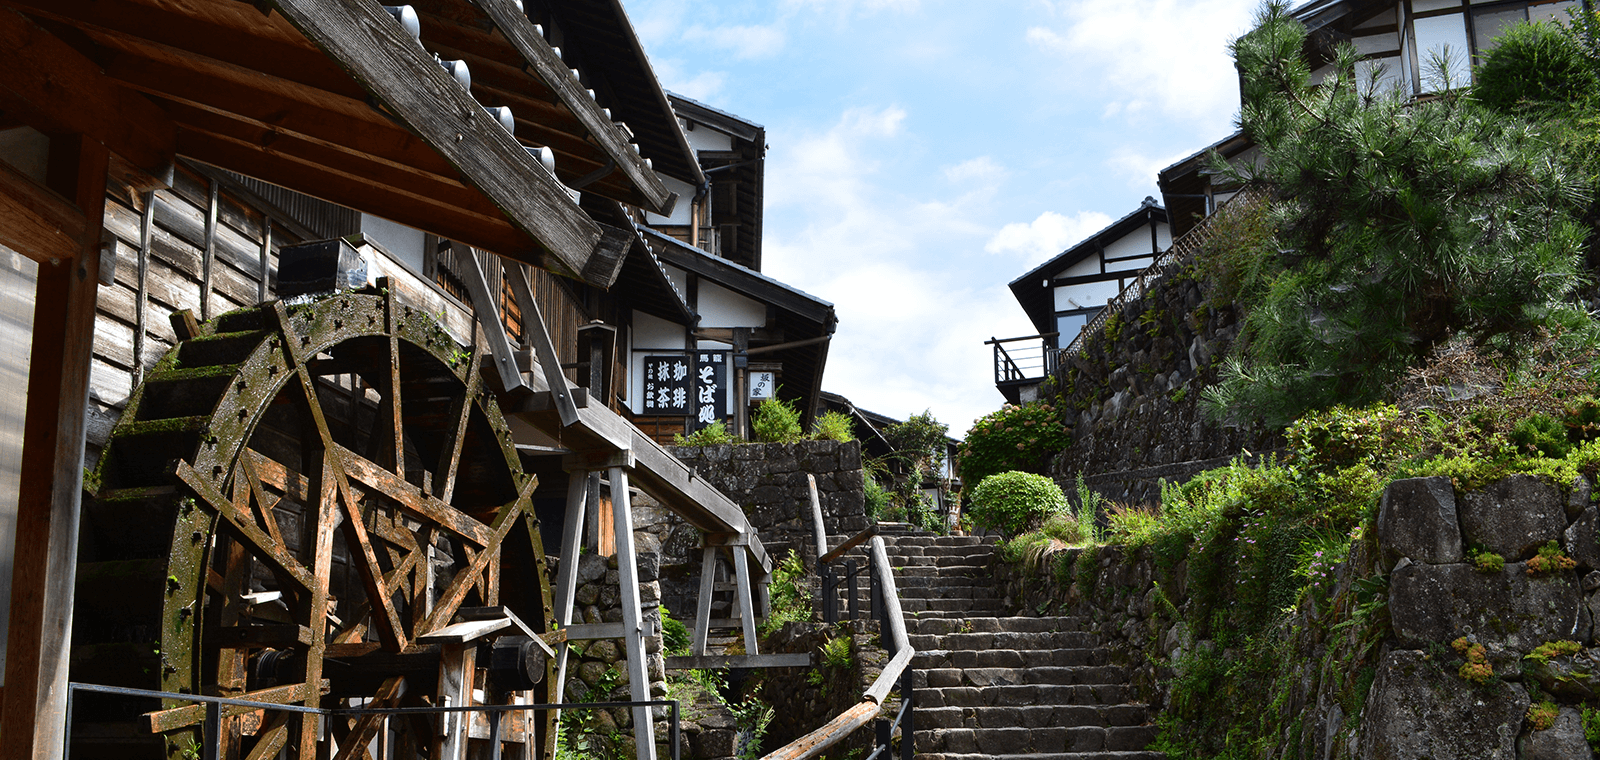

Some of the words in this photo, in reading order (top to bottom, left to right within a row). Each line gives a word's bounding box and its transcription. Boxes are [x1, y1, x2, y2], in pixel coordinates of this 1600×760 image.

[657, 361, 670, 409] 抹茶
[673, 360, 687, 409] 珈琲
[698, 365, 718, 424] そば処
